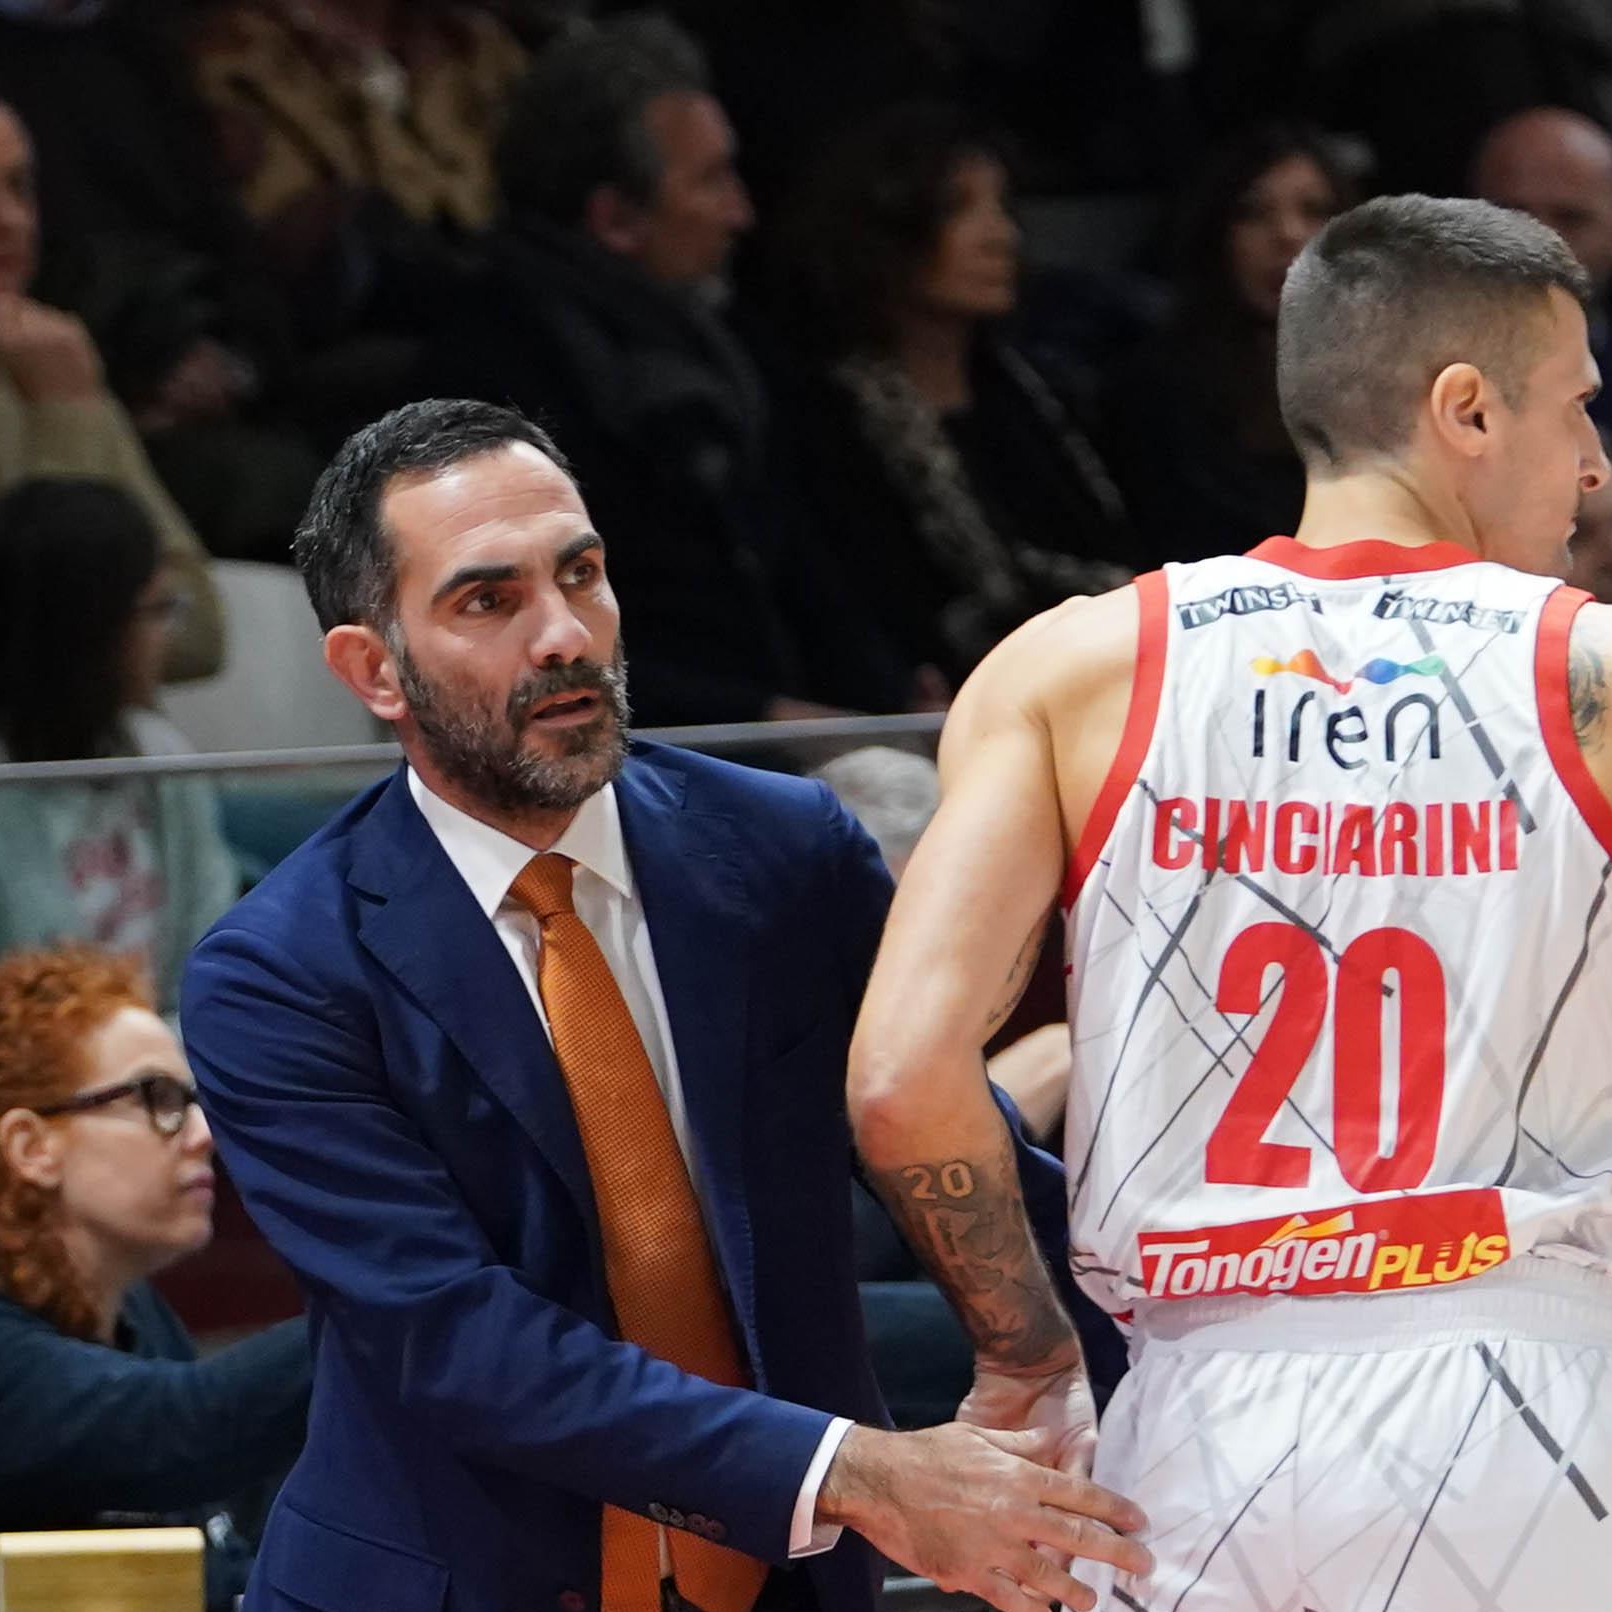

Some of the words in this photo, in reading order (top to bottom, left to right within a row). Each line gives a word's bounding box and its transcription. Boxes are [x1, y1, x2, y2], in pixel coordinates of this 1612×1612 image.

[1152, 796, 1519, 877] CINCIARINI
[1205, 921, 1445, 1194] 20
[900, 1160, 974, 1201] 20
[1141, 1231, 1377, 1297] Tonogen
[1368, 1232, 1509, 1290] PLUS
